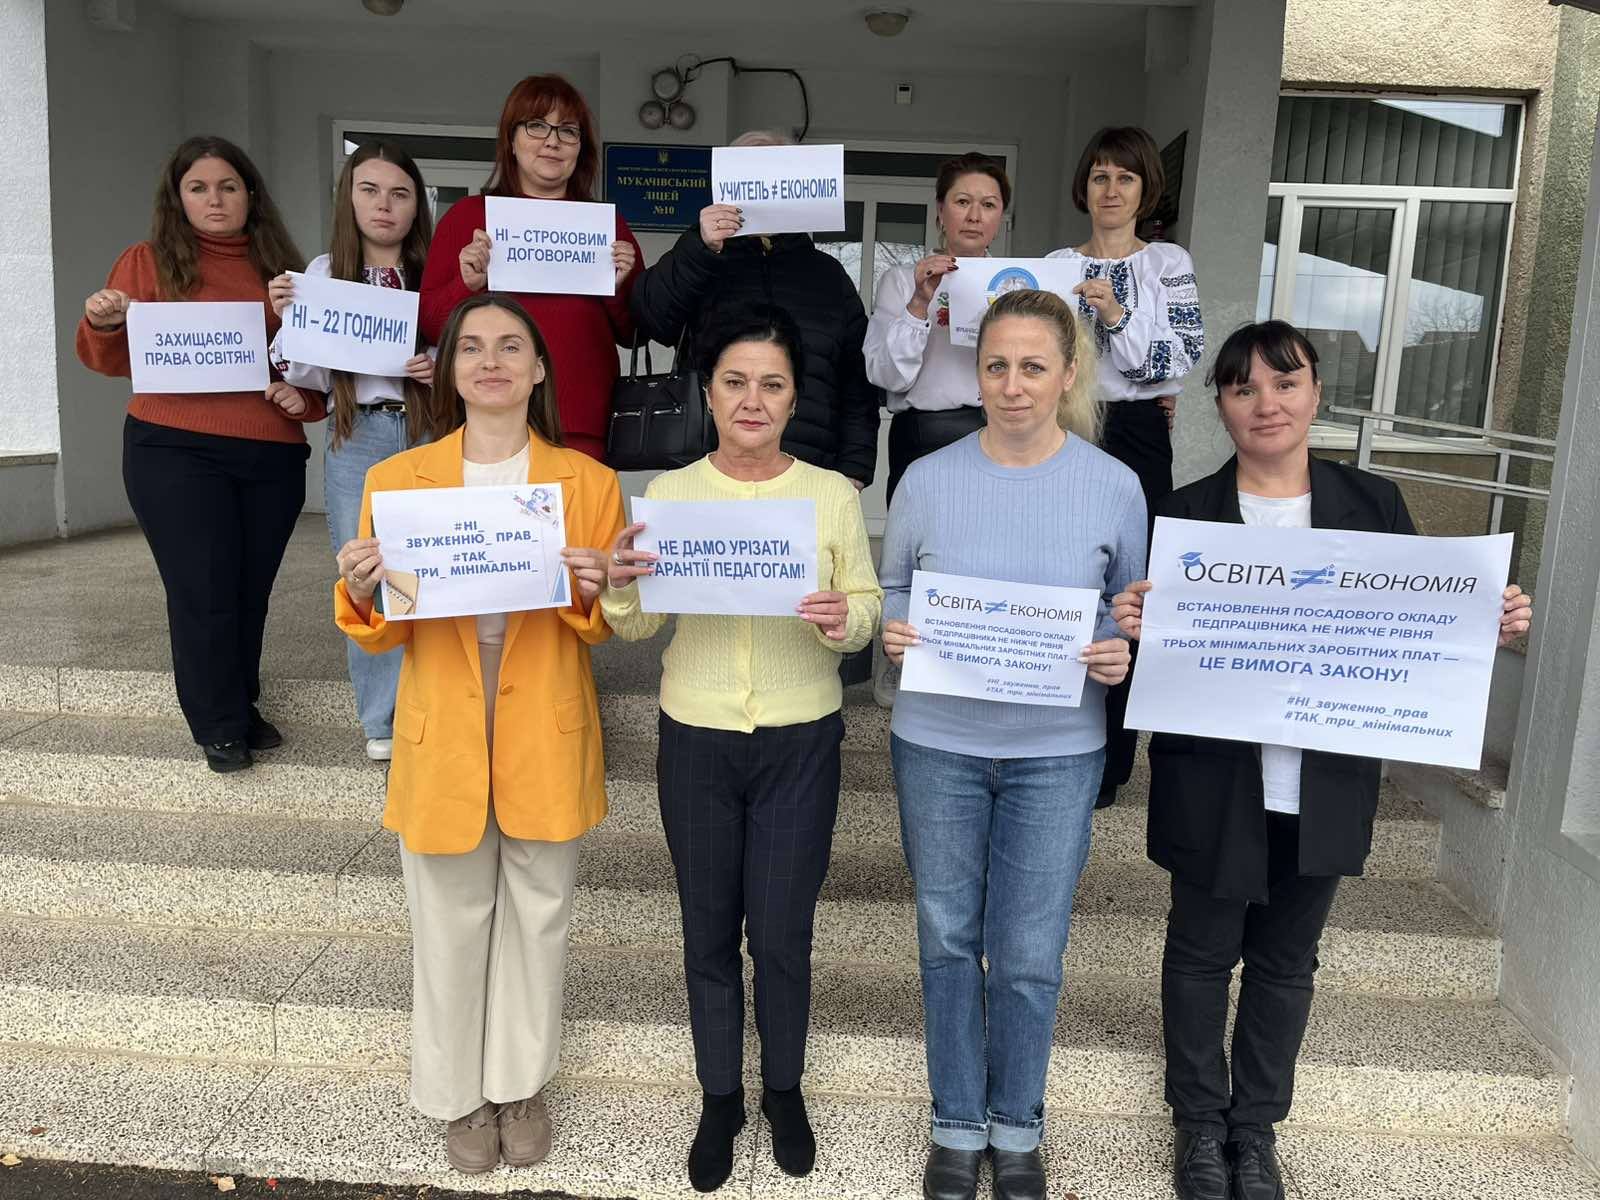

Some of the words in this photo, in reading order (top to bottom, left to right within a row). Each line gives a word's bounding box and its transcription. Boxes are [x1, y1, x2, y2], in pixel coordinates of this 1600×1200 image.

[616, 175, 706, 188] МУКАЧІВСЬКИЙ
[719, 180, 769, 201] УЧИТЕЛЬ
[780, 178, 838, 199] ЕКОНОМІЯ
[643, 190, 679, 201] ЛІЦЕЙ
[653, 205, 675, 215] №10
[495, 228, 508, 241] НІ
[523, 229, 608, 246] СТРОКОВИМ
[507, 247, 596, 264] ДОГОВОРАМ!
[292, 303, 307, 329] НІ
[322, 309, 340, 334] 22
[343, 312, 408, 344] ГОДИНИ!
[155, 331, 243, 348] ЗАХИЩАЄМО
[145, 352, 192, 366] ПРАВА
[194, 350, 256, 365] ОСВІТЯН!
[453, 520, 485, 532] #НІ_
[406, 533, 492, 548] ЗВУЖЕННЮ_
[496, 530, 538, 543] ПРАВ_
[452, 551, 494, 563] #ТАК_
[658, 540, 677, 556] НЕ
[682, 540, 726, 558] ДАМО
[729, 540, 790, 556] УРІЗАТИ
[413, 567, 446, 580] ТРИ_
[450, 561, 538, 576] МІНІМАЛЬНІ_
[713, 562, 805, 580] ПЕДАГОГАМ!
[1184, 560, 1285, 586] ОСВІТА
[1339, 571, 1478, 594] ЕКОНОМІЯ
[928, 592, 983, 612] ОСВІТА
[1010, 604, 1083, 622] ЕКОНОМІЯ
[1177, 601, 1290, 616] ВСТАНОВЛЕННЯ
[1293, 607, 1394, 621] ПОСАДОВОГО
[1398, 612, 1457, 626] ОКЛАДУ
[987, 624, 1042, 638] ПОСАДОВОГО
[1043, 632, 1076, 642] ОКЛАДУ
[1192, 618, 1307, 633] ПЕДПРАЦІВНИКА
[1312, 624, 1331, 634] НЕ
[1335, 625, 1387, 637] НИЖЧЕ
[1390, 628, 1434, 640] РІВНЯ
[933, 629, 997, 642] ПЕДПРАЦІВНИКА
[1010, 639, 1038, 648] НИЖЧЕ
[1039, 641, 1064, 650] РІВНЯ
[943, 640, 997, 652] МІНІМАЛЬНИХ
[997, 646, 1046, 658] ЗАРОБІТНИХ
[1047, 652, 1068, 661] ПЛАТ
[1162, 638, 1207, 649] ТРЬОХ
[1209, 640, 1305, 653] МІНІМАЛЬНИХ
[1307, 644, 1399, 659] ЗАРОБІТНИХ
[1401, 650, 1441, 662] ПЛАТ
[938, 650, 953, 660] ЦЕ
[956, 653, 1001, 667] ВИМОГА
[1004, 658, 1052, 673] ЗАКОНУ!
[1199, 656, 1226, 671] ЦЕ
[1231, 657, 1314, 676] ВИМОГА
[1319, 664, 1409, 683] ЗАКОНУ!
[1287, 695, 1429, 720] #НІ_звуженню_прав
[1284, 710, 1453, 738] #ТАК_три_мінімальних
